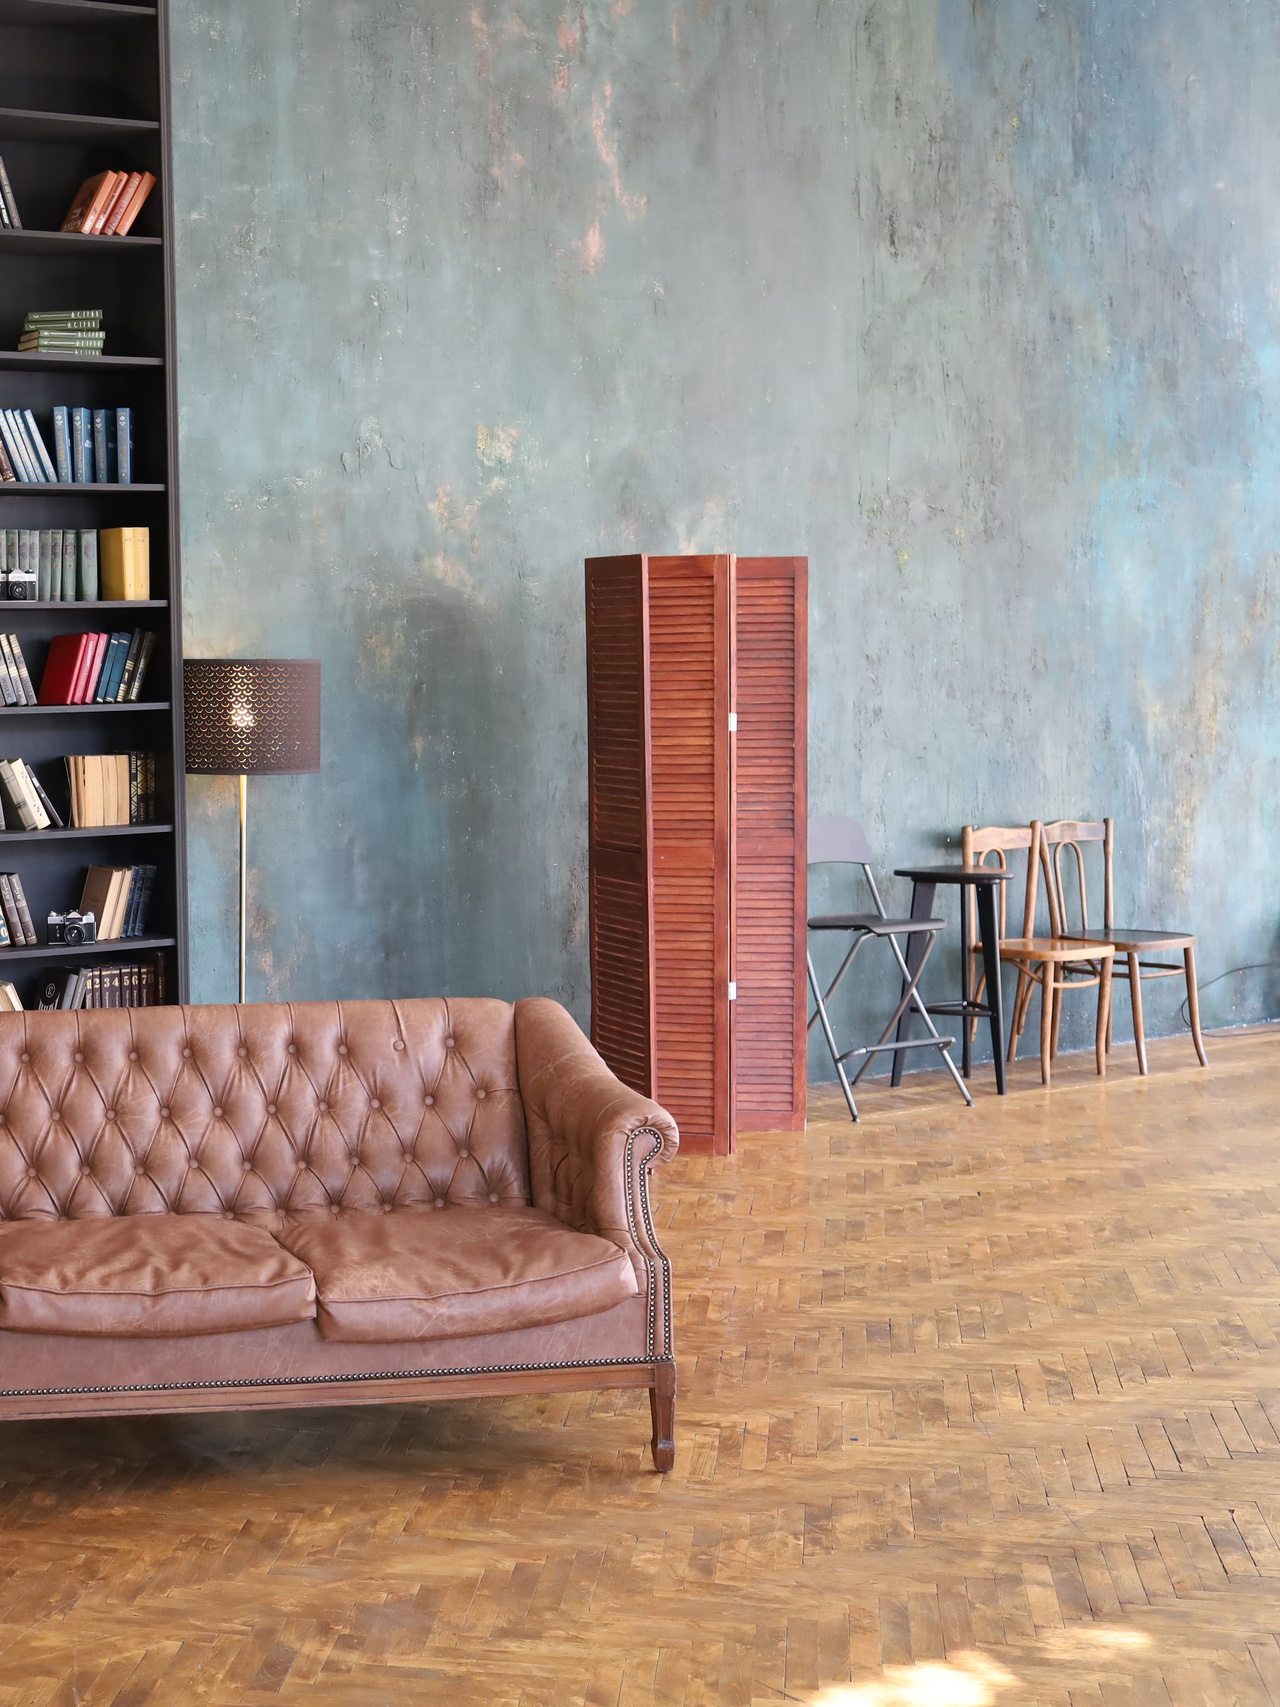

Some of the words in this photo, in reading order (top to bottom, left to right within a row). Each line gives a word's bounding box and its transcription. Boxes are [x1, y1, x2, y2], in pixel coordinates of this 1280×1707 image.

[93, 978, 100, 989] 2
[104, 978, 110, 988] 3
[112, 977, 119, 987] 4
[123, 976, 130, 986] 5
[131, 975, 139, 985] 6
[141, 974, 148, 984] 7
